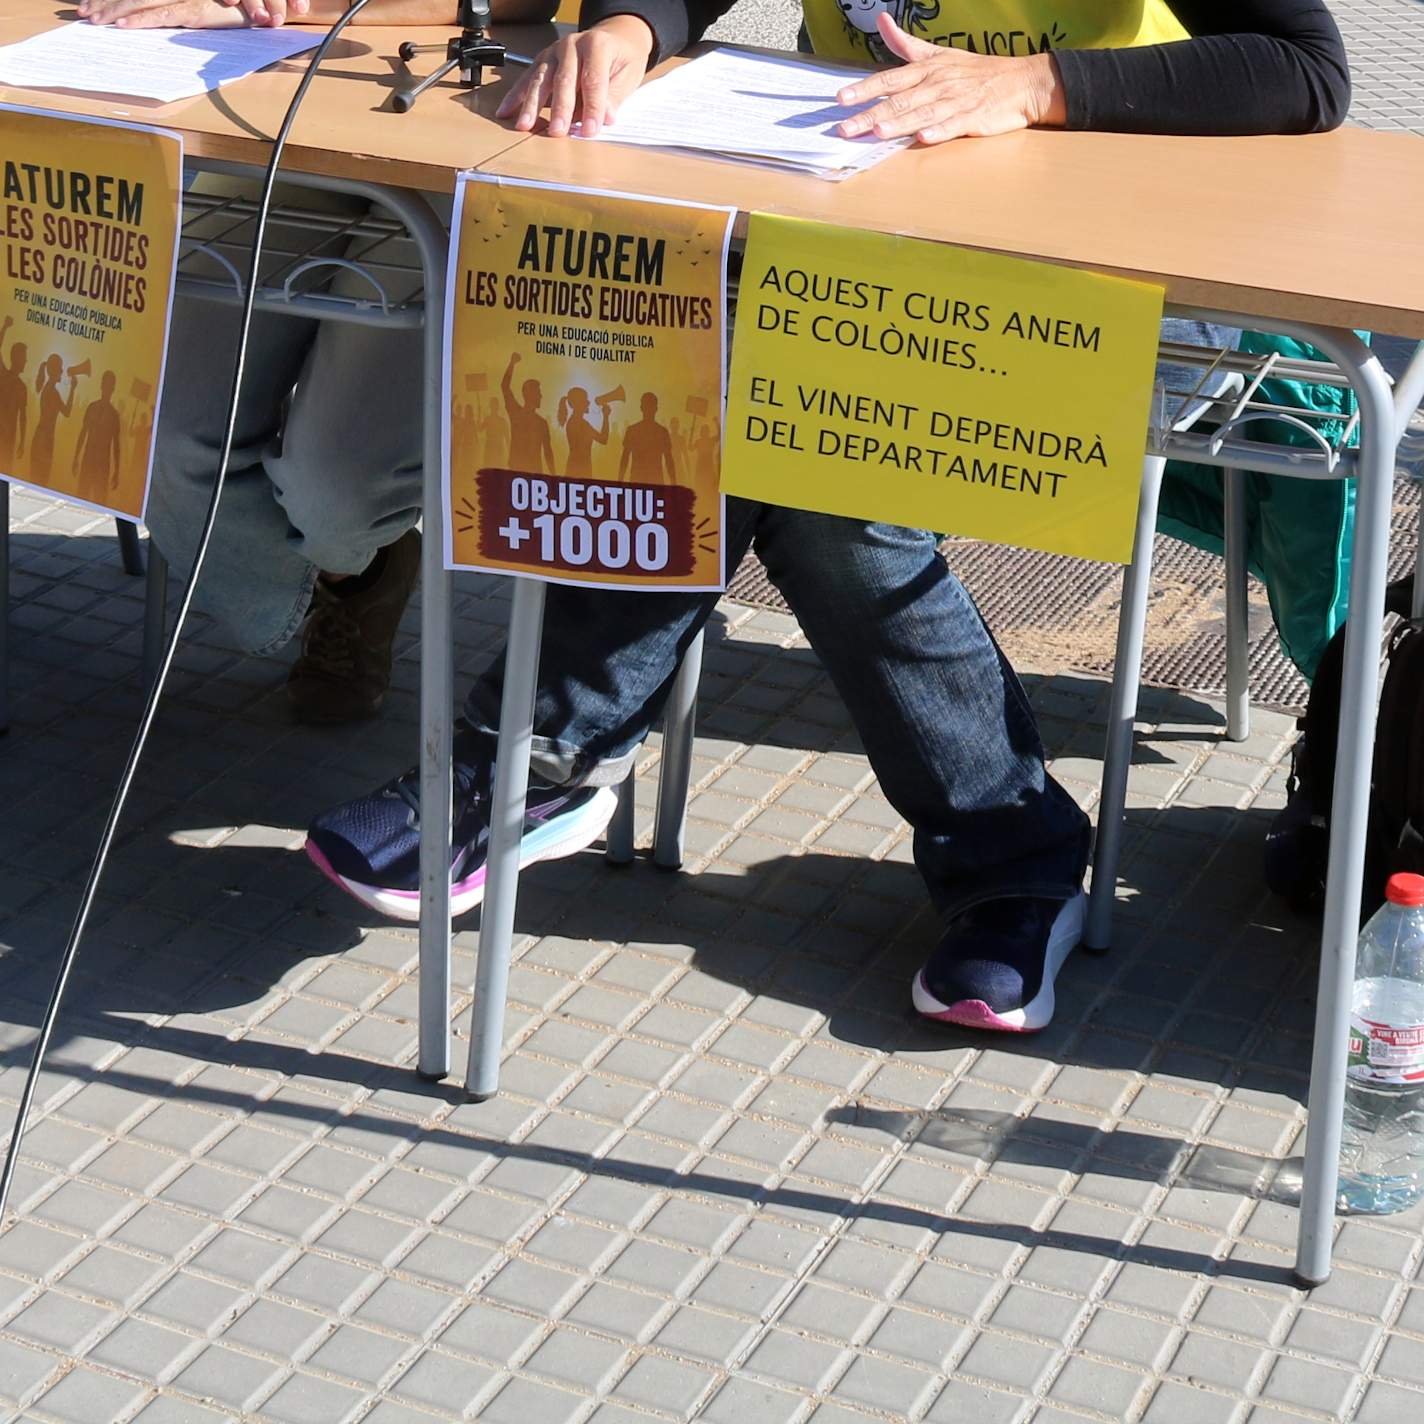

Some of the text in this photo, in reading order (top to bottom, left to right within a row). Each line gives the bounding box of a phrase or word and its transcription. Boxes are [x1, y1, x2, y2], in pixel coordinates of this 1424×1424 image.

[3, 160, 144, 227] ATUREM
[43, 212, 149, 271] SORTIDES
[518, 224, 666, 286] ATUREM
[7, 245, 45, 285] LES
[52, 251, 146, 314] COLÒNIES
[14, 287, 123, 331] PER UNA EDUCACIÓ PÚBLICA
[465, 270, 713, 330] LES SORTIDES EDUCATIVES
[759, 264, 1102, 353] AQUEST CURS ANEM
[26, 308, 106, 344] DIGNA I DE QUALITAT
[517, 320, 655, 348] PER UNA EDUCACIÓ PÚBLICA
[535, 340, 636, 364] DIGNA I DE QUALITAT
[757, 304, 1008, 376] DE COLÒNIES...
[749, 376, 1109, 468] EL VINENT DEPENDRÀ
[745, 415, 1068, 498] DEL DEPARTAMENT
[511, 477, 666, 522] OBJECTIU:
[498, 514, 670, 572] +1000
